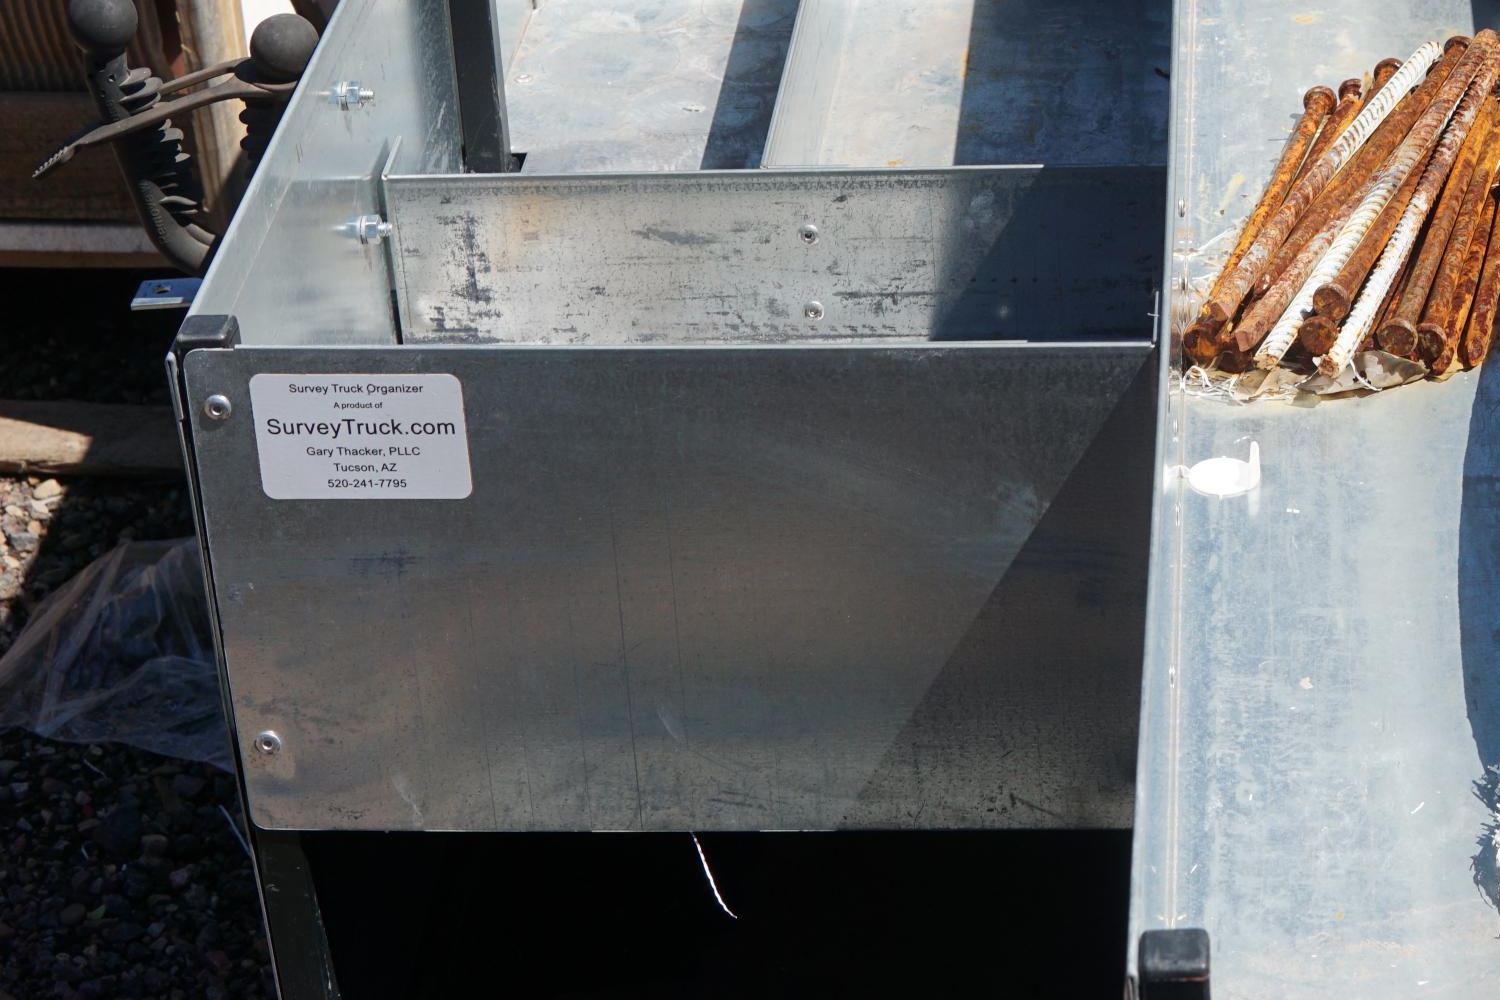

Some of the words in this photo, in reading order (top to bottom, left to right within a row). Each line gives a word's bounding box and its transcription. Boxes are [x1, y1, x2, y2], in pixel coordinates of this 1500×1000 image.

[289, 384, 328, 395] Survey
[332, 384, 363, 393] Truck
[367, 384, 423, 395] Organizer
[341, 402, 373, 410] product
[267, 418, 456, 439] SurveyTruck.com
[306, 446, 334, 458] Gary
[336, 446, 386, 458] Thacker,
[389, 447, 421, 456] PLLC
[333, 463, 379, 473] Tucson,
[381, 463, 398, 472] AZ
[328, 479, 407, 488] 520-241-7795
